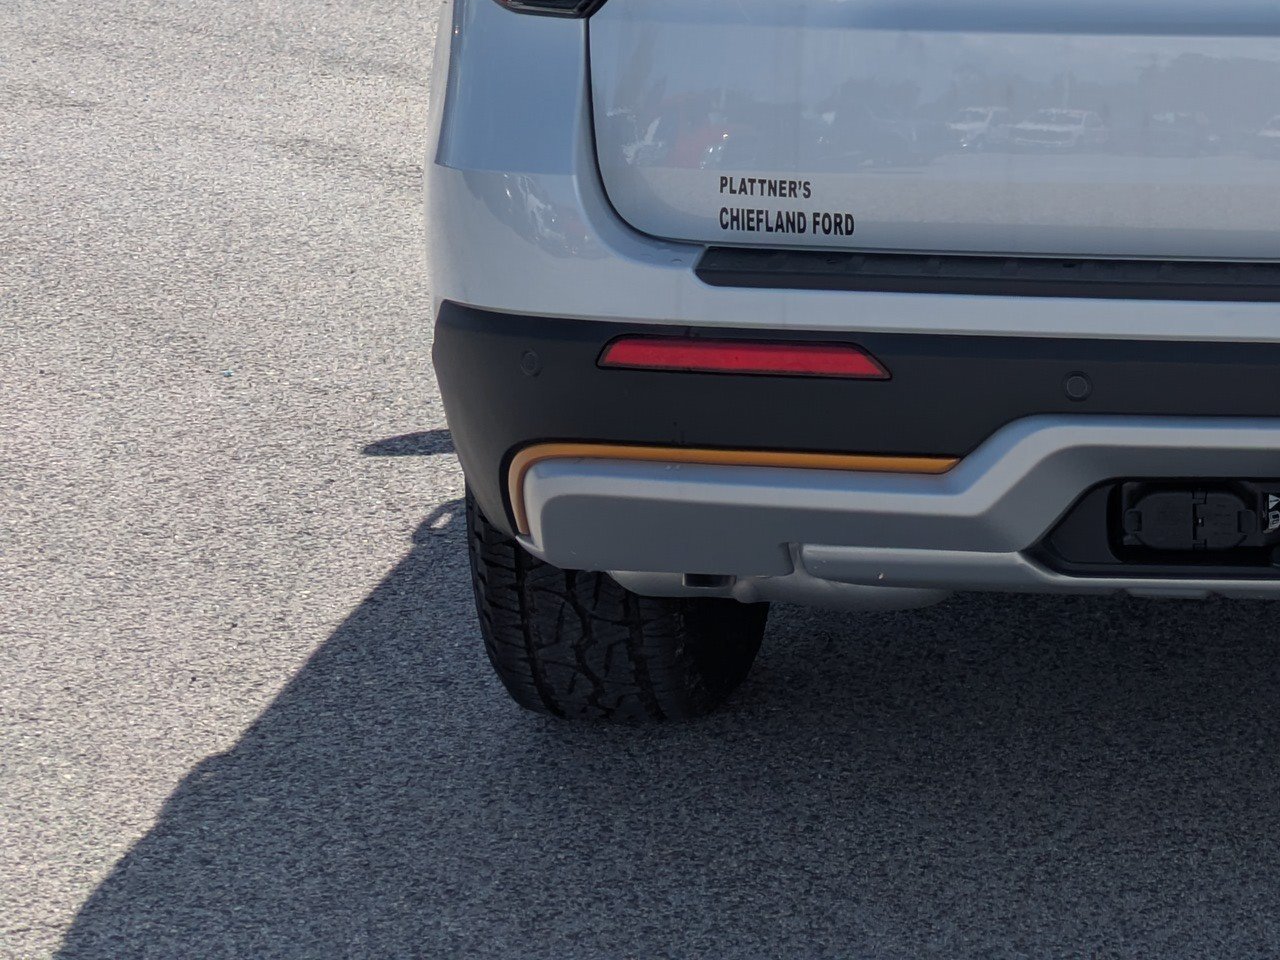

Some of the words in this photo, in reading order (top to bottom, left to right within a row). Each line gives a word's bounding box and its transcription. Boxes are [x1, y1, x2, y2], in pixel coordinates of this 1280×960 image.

[719, 176, 812, 199] PLATTNER'S
[719, 206, 807, 234] CHIEFLAND
[812, 212, 855, 236] FORD
